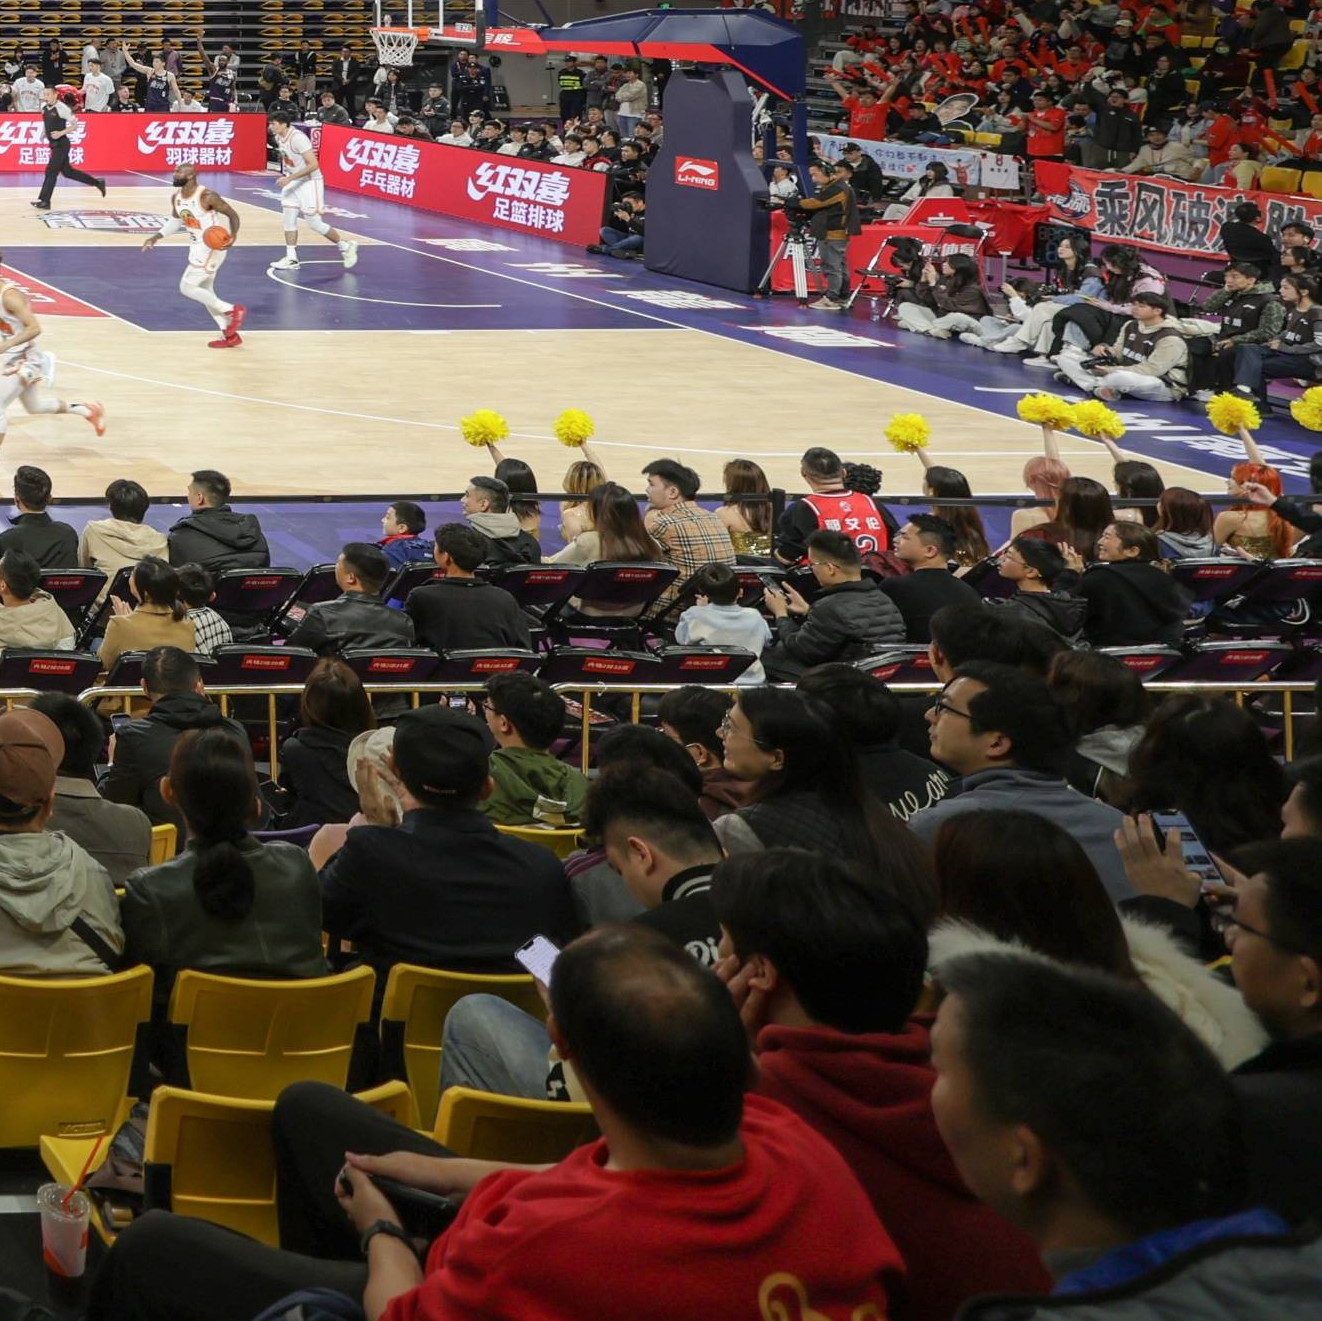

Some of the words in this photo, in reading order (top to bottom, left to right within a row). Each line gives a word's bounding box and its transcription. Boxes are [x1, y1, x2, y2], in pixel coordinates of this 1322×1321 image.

[138, 119, 234, 156] 红双喜
[19, 148, 85, 166] 足篮球
[165, 148, 233, 167] 羽球器材
[339, 137, 421, 175] 红双喜
[359, 169, 415, 200] 乒乓器材
[467, 161, 571, 207] 红双喜
[677, 175, 716, 186] LI-NING
[493, 198, 565, 233] 足篮排球
[825, 517, 881, 531] 郭艾伦
